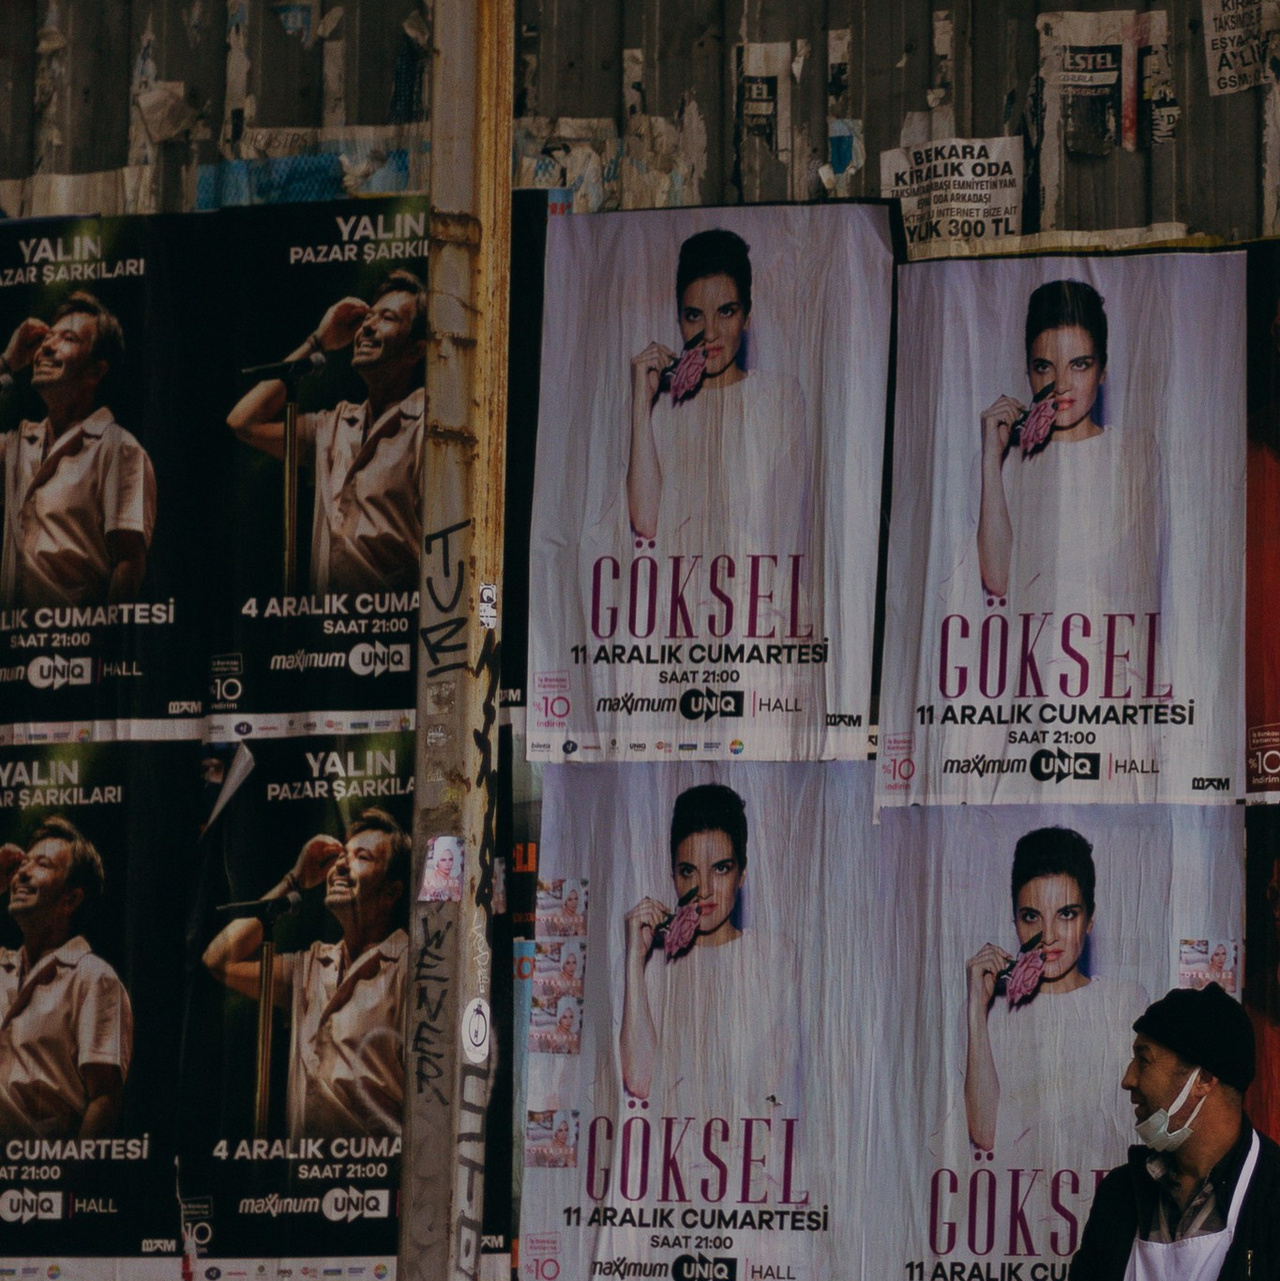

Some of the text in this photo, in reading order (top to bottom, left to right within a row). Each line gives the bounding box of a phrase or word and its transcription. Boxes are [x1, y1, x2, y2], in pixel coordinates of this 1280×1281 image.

[913, 145, 989, 166] BEKARA
[972, 161, 1013, 177] ODA
[948, 218, 1015, 237] 300 TL
[19, 235, 102, 264] YALIN
[288, 243, 358, 266] PAZAR
[42, 258, 145, 284] ŞARKILARI
[591, 539, 814, 640] GÖKSEL
[241, 594, 347, 620] 4 ARALIK
[322, 617, 409, 636] SAAT 21:00
[54, 631, 91, 648] 21:00
[594, 637, 829, 665] ARALIK CUMARTESİ
[938, 597, 1174, 701] GÖKSEL
[658, 670, 699, 684] SAAT
[596, 691, 678, 714] maximum
[759, 698, 802, 712] HALL
[916, 698, 1195, 726] 11 CUMARTESİ
[306, 750, 397, 779] YALIN
[943, 753, 1027, 778] maximum
[1115, 756, 1160, 774] HALL
[18, 785, 122, 810] ŞARKILARI
[266, 782, 328, 802] PAZAR
[212, 1136, 325, 1160] 4 ARALIK
[585, 1100, 810, 1204] GÖKSEL
[297, 1162, 388, 1180] SAAT 21:00
[563, 1205, 829, 1232] 11 CUMARTESİ
